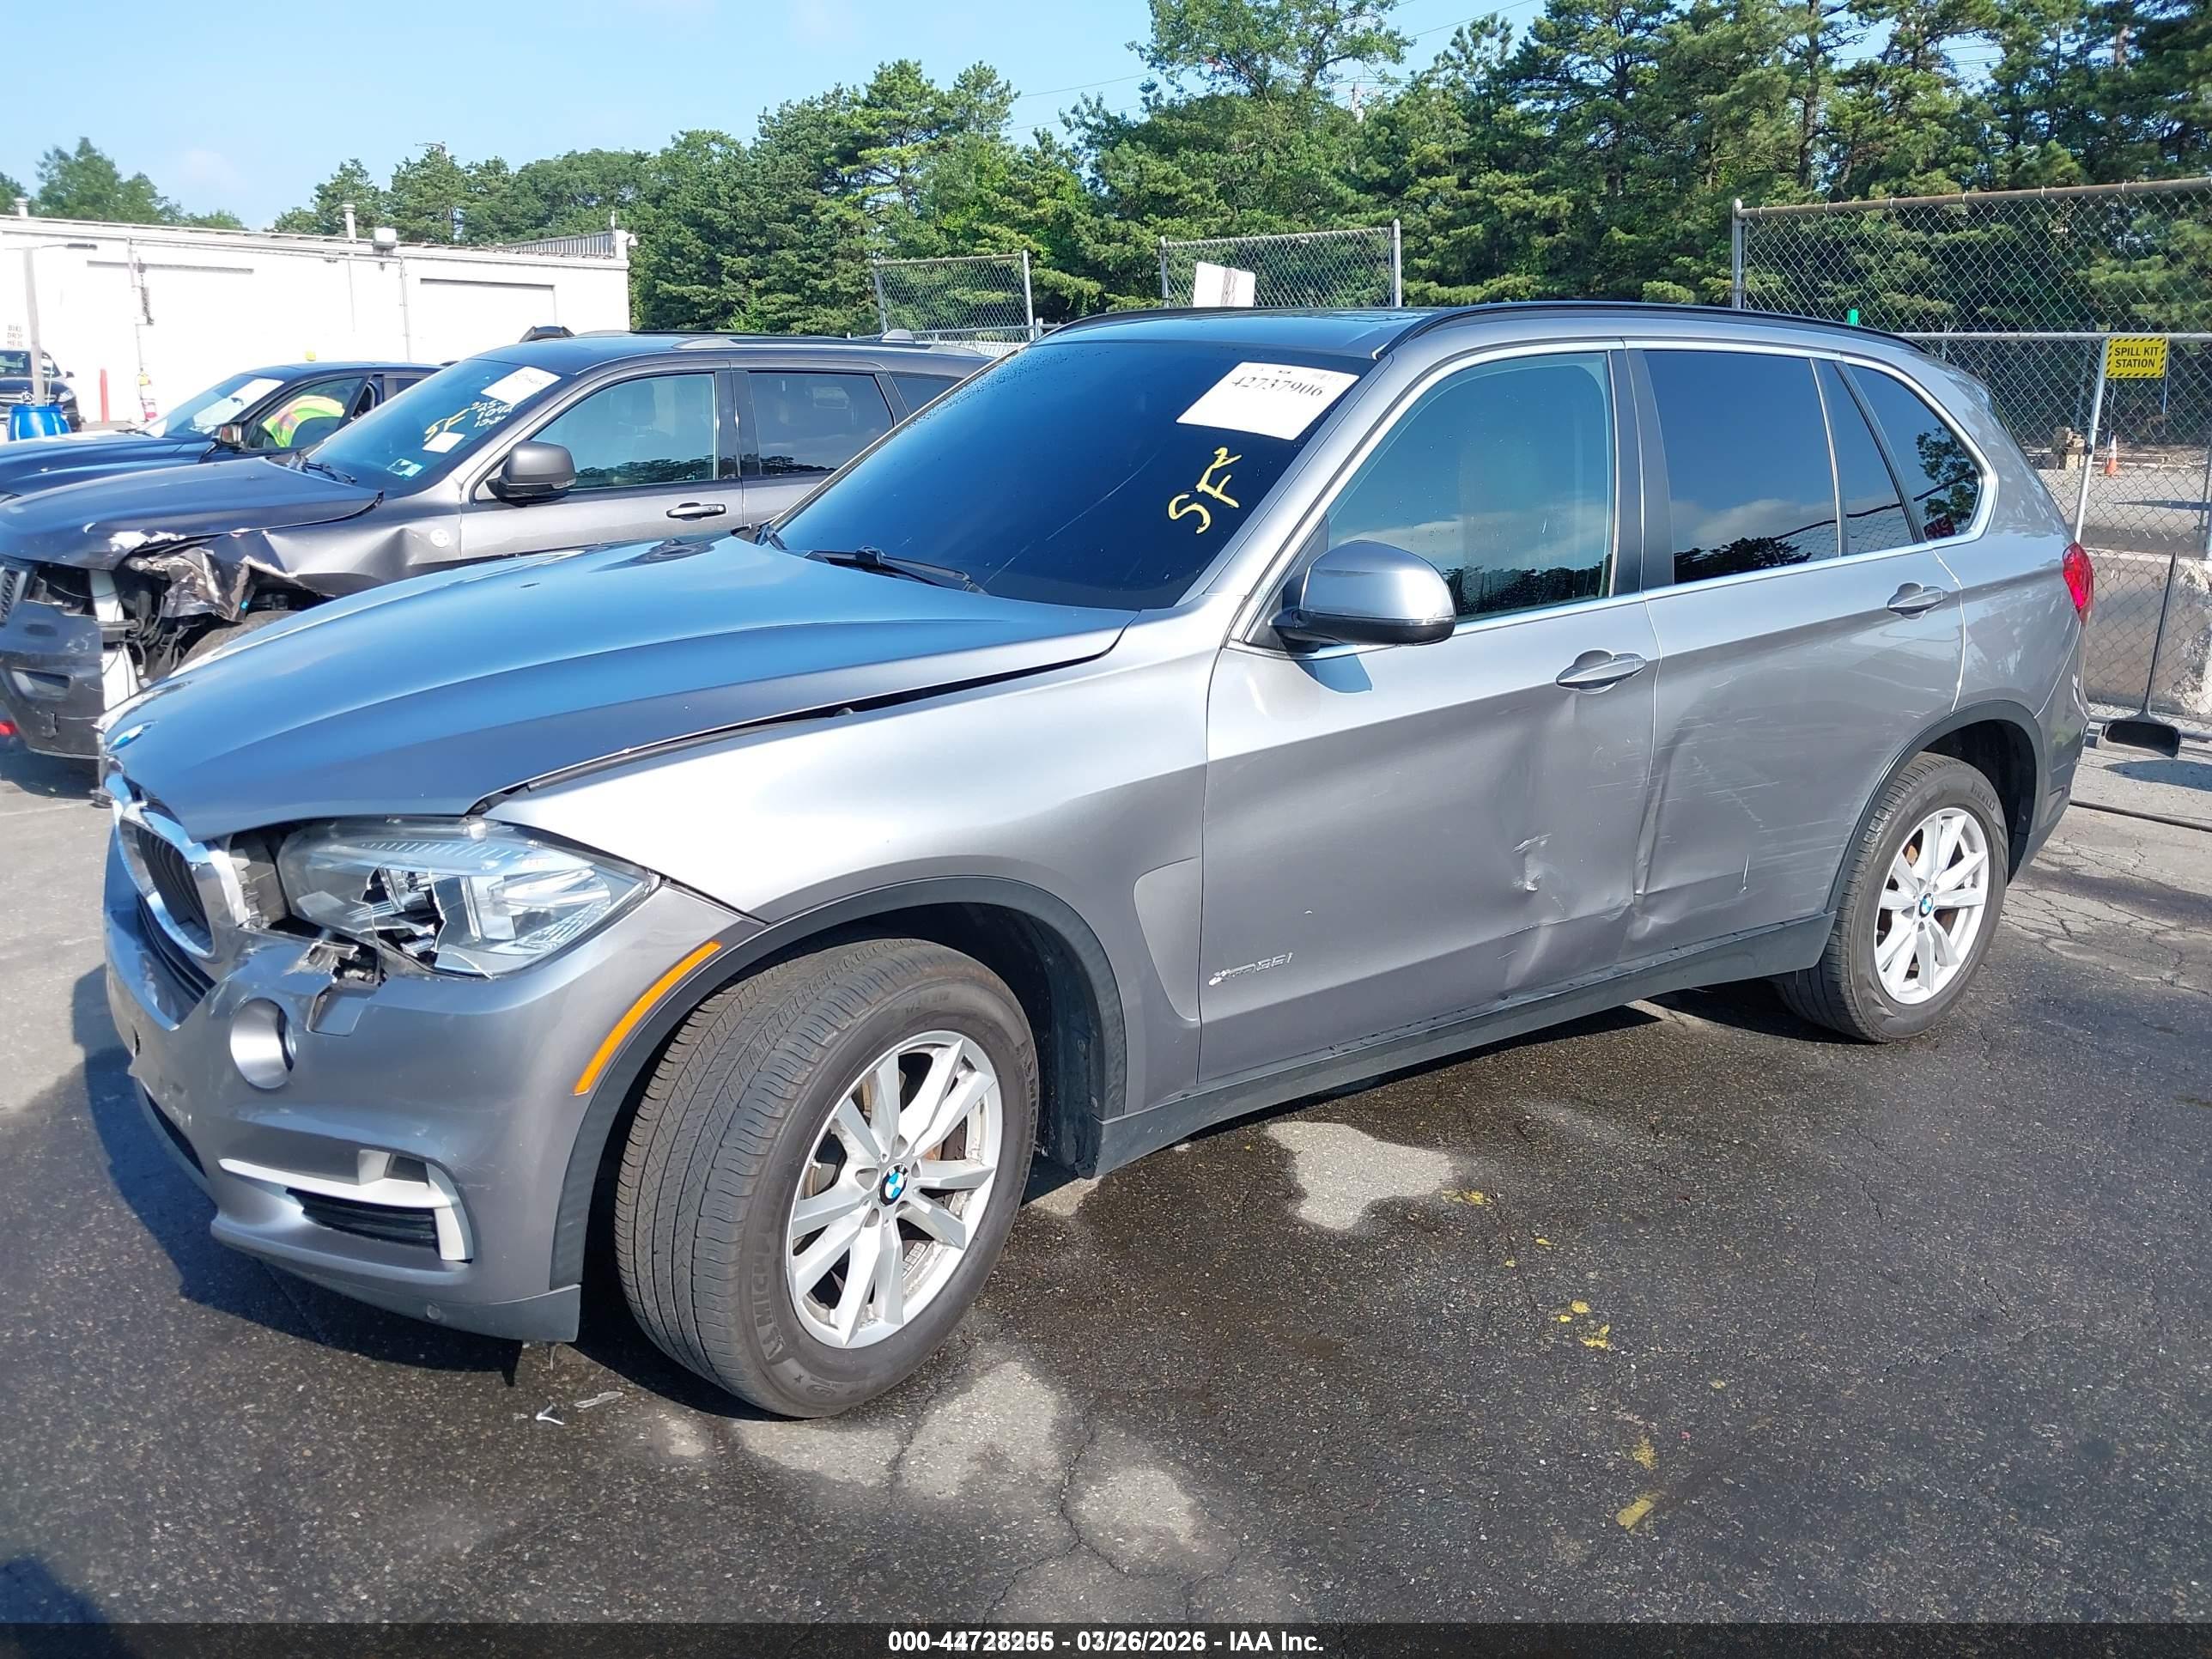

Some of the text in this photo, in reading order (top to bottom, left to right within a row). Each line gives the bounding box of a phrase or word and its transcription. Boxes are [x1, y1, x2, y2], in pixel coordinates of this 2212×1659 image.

[2114, 346, 2160, 356] SPILL KIT
[2115, 358, 2155, 368] STATION
[1231, 376, 1324, 397] 42737906
